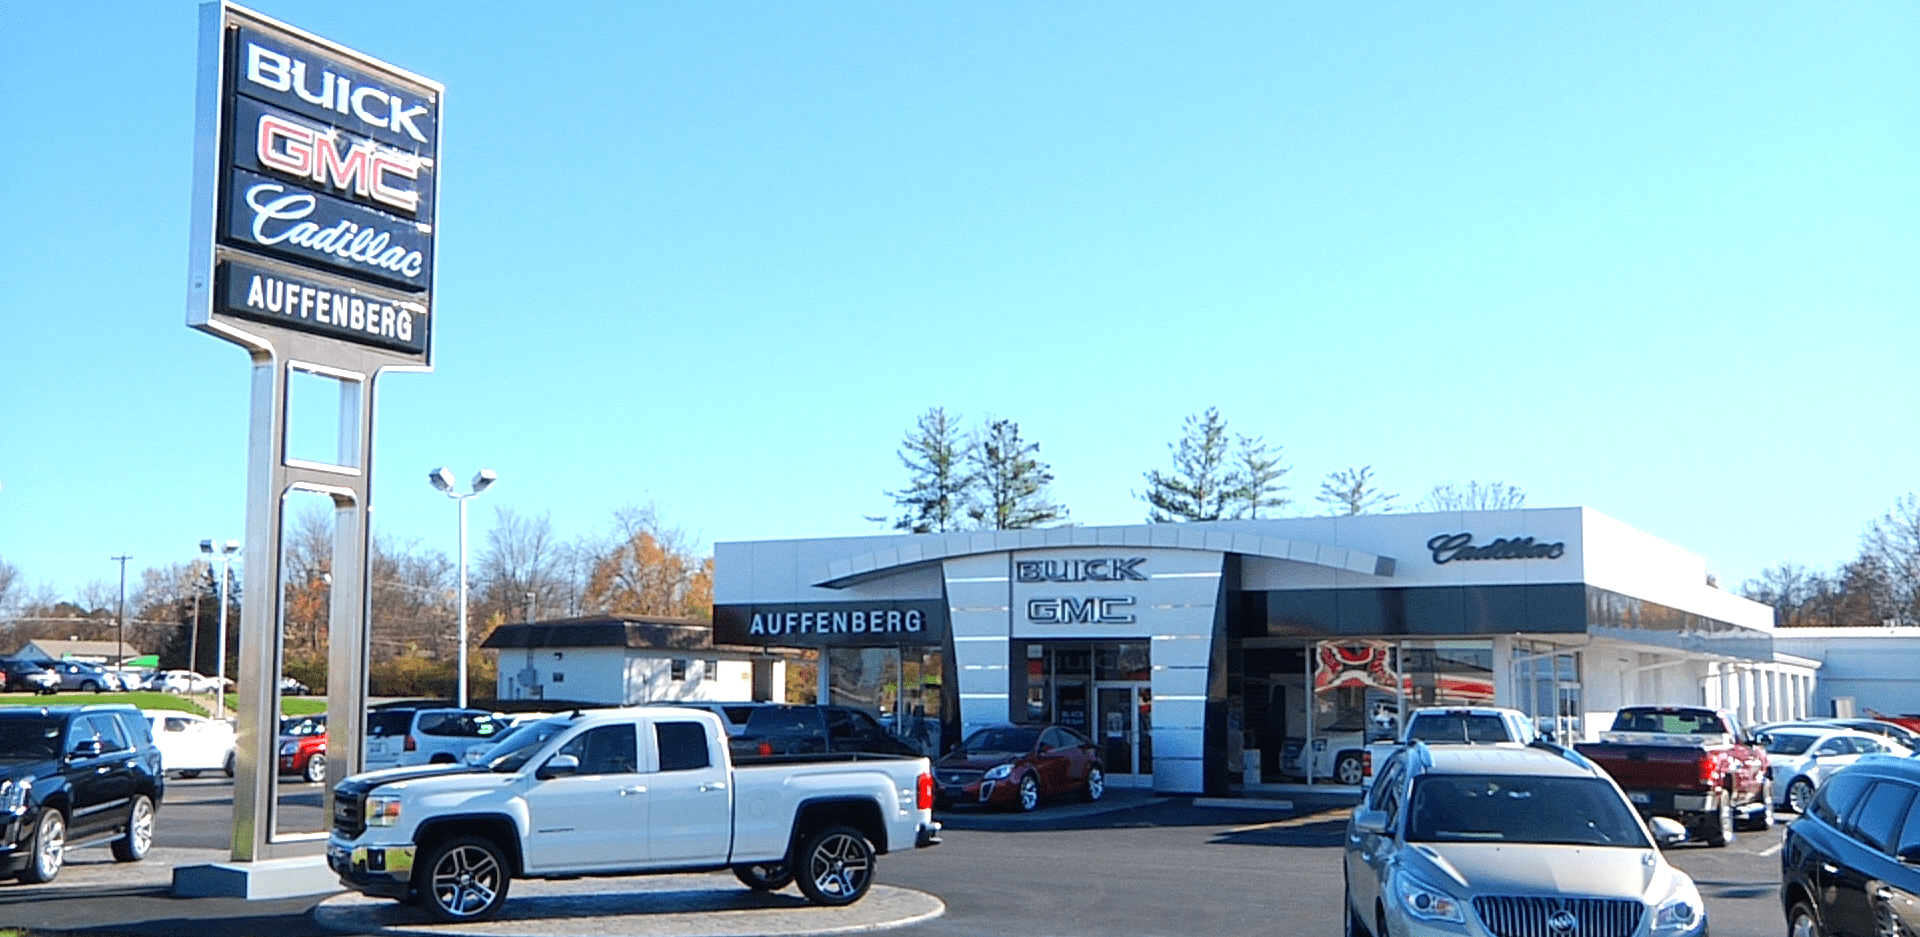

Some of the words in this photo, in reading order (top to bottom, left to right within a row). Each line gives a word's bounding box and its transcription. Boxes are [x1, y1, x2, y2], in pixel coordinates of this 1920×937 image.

[248, 43, 428, 143] BUICK
[257, 114, 419, 212] GMC
[246, 184, 422, 277] Cadillac
[247, 275, 412, 341] AUFFENBERG
[1016, 557, 1147, 582] BUICK
[1427, 533, 1564, 564] Cadillac
[750, 610, 922, 634] AUFFENBERG
[1027, 597, 1136, 623] GMC
